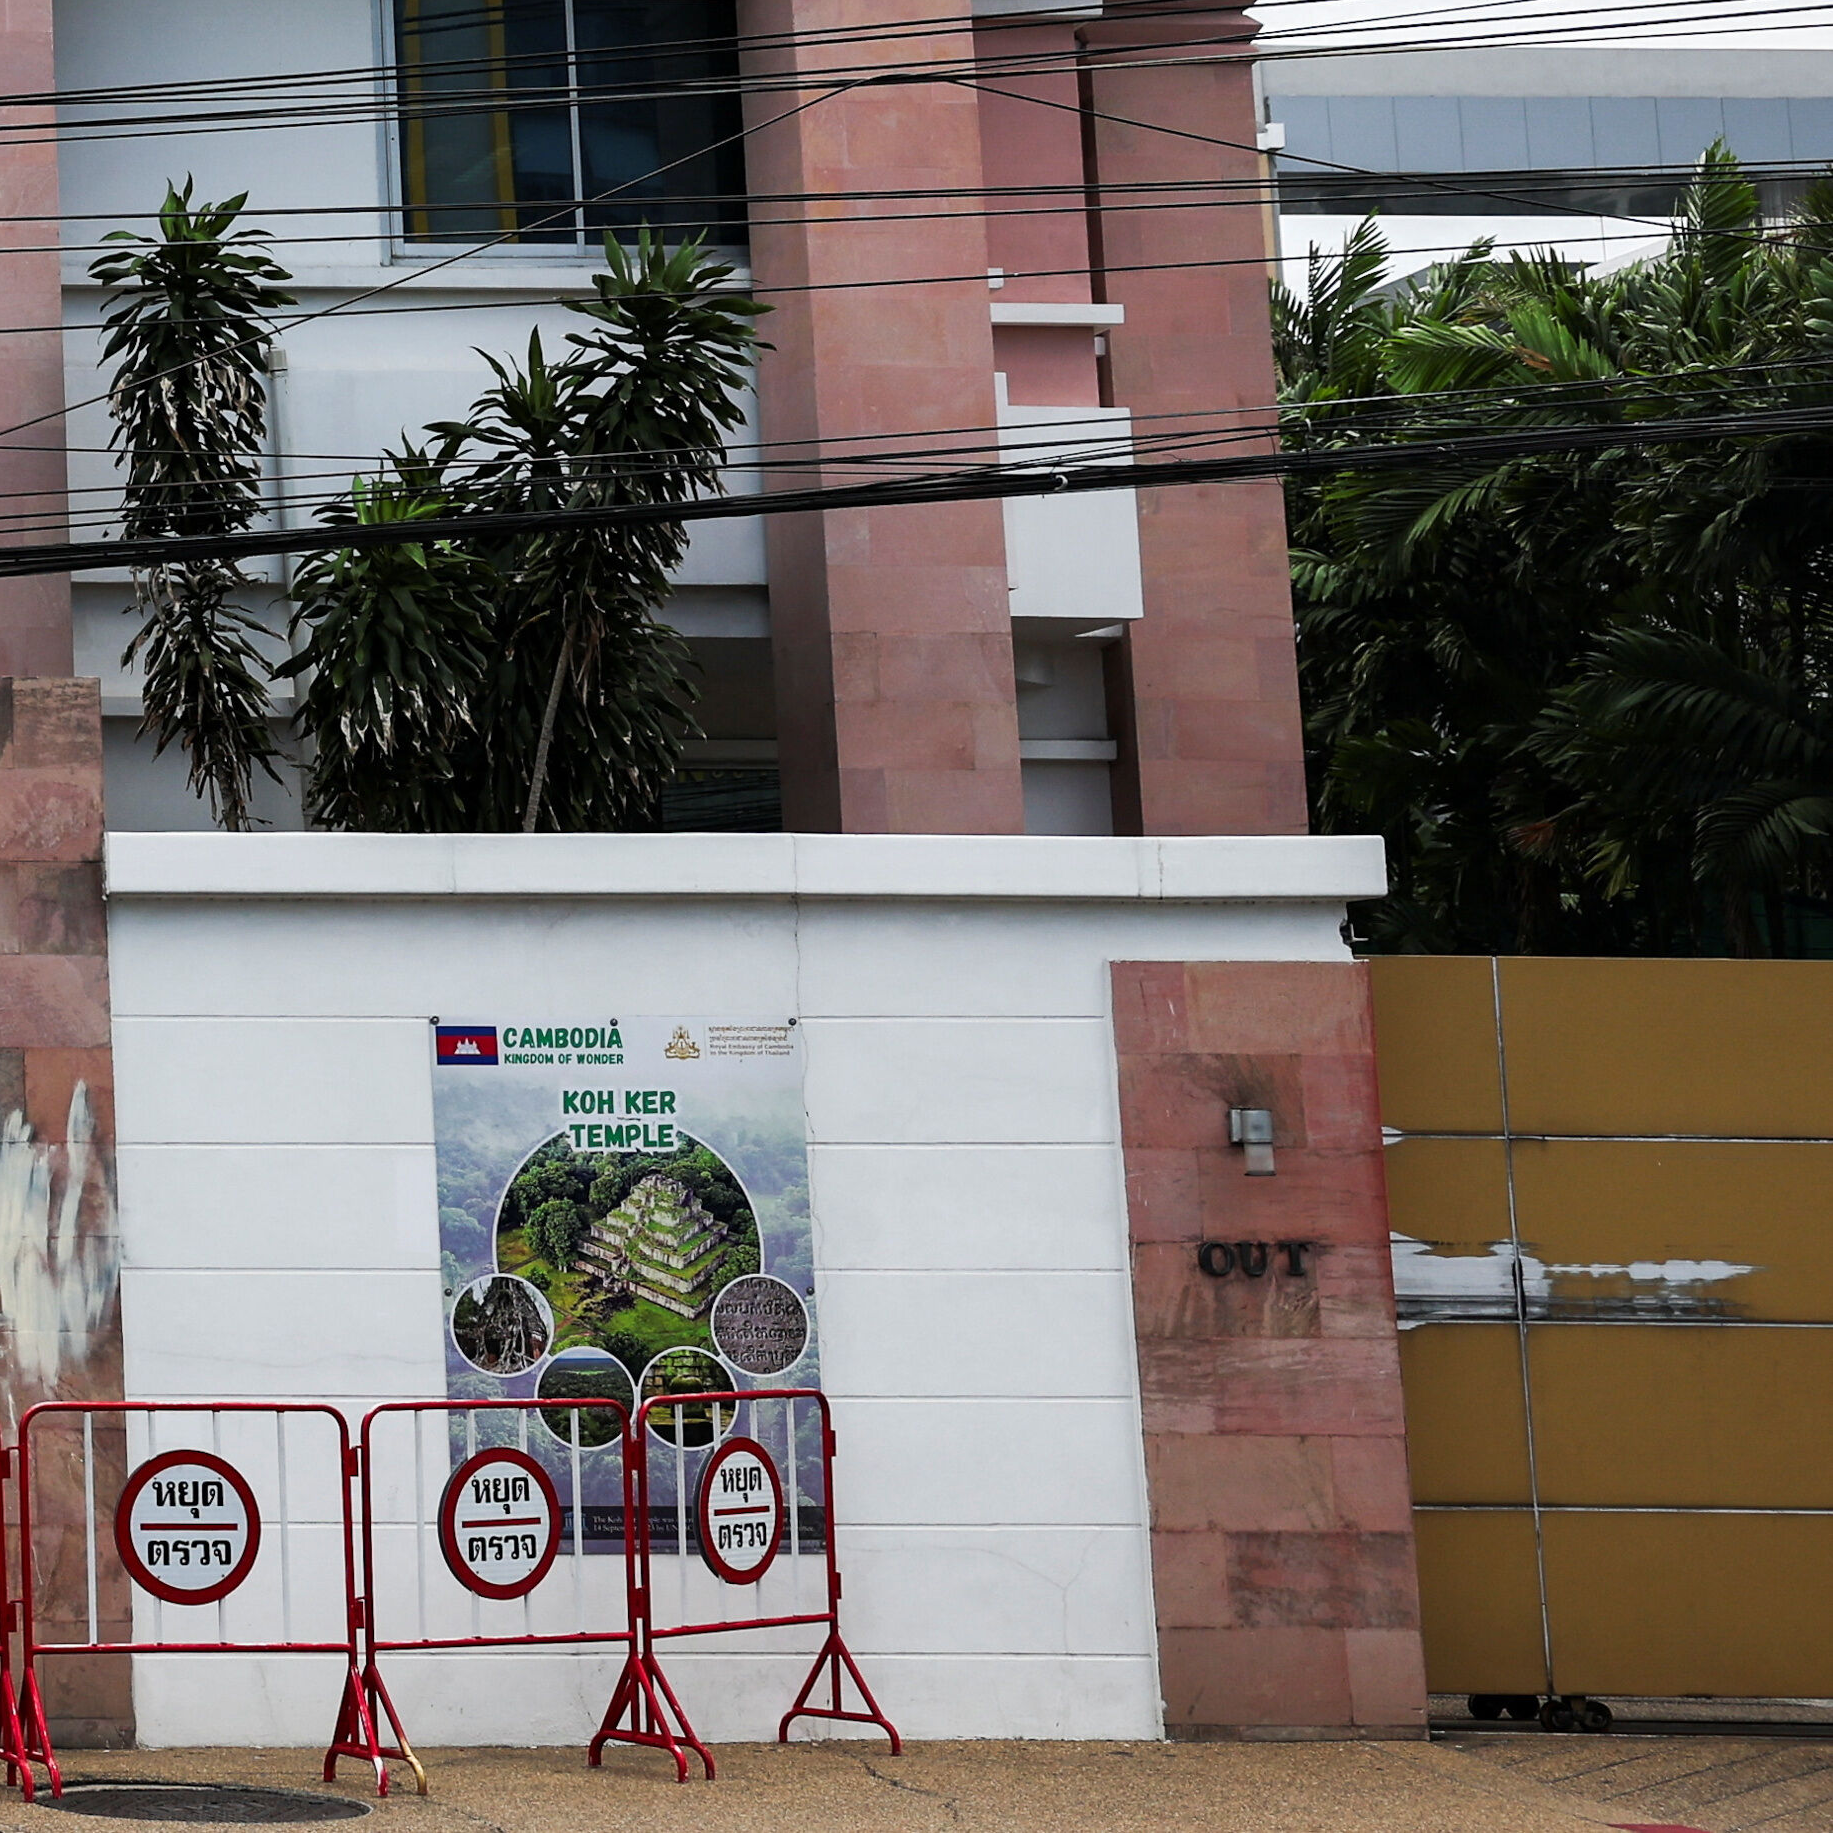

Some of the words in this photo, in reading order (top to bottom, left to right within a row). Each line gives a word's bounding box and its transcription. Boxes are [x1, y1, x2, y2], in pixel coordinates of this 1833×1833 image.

[503, 1027, 623, 1049] CAMBODIA
[504, 1054, 554, 1064] KINGDOM
[558, 1054, 572, 1064] OF
[577, 1054, 624, 1064] WONDER
[563, 1091, 614, 1114] KOH
[625, 1091, 676, 1114] KER
[569, 1124, 674, 1148] TEMPLE
[1198, 1241, 1309, 1277] OUT
[472, 1477, 529, 1514] หยุด
[721, 1467, 761, 1504] หยุด
[152, 1481, 223, 1518] หยุด
[469, 1534, 536, 1562] ตรวจ
[719, 1522, 766, 1549] ตรวจ
[148, 1540, 231, 1565] ตรวจ
